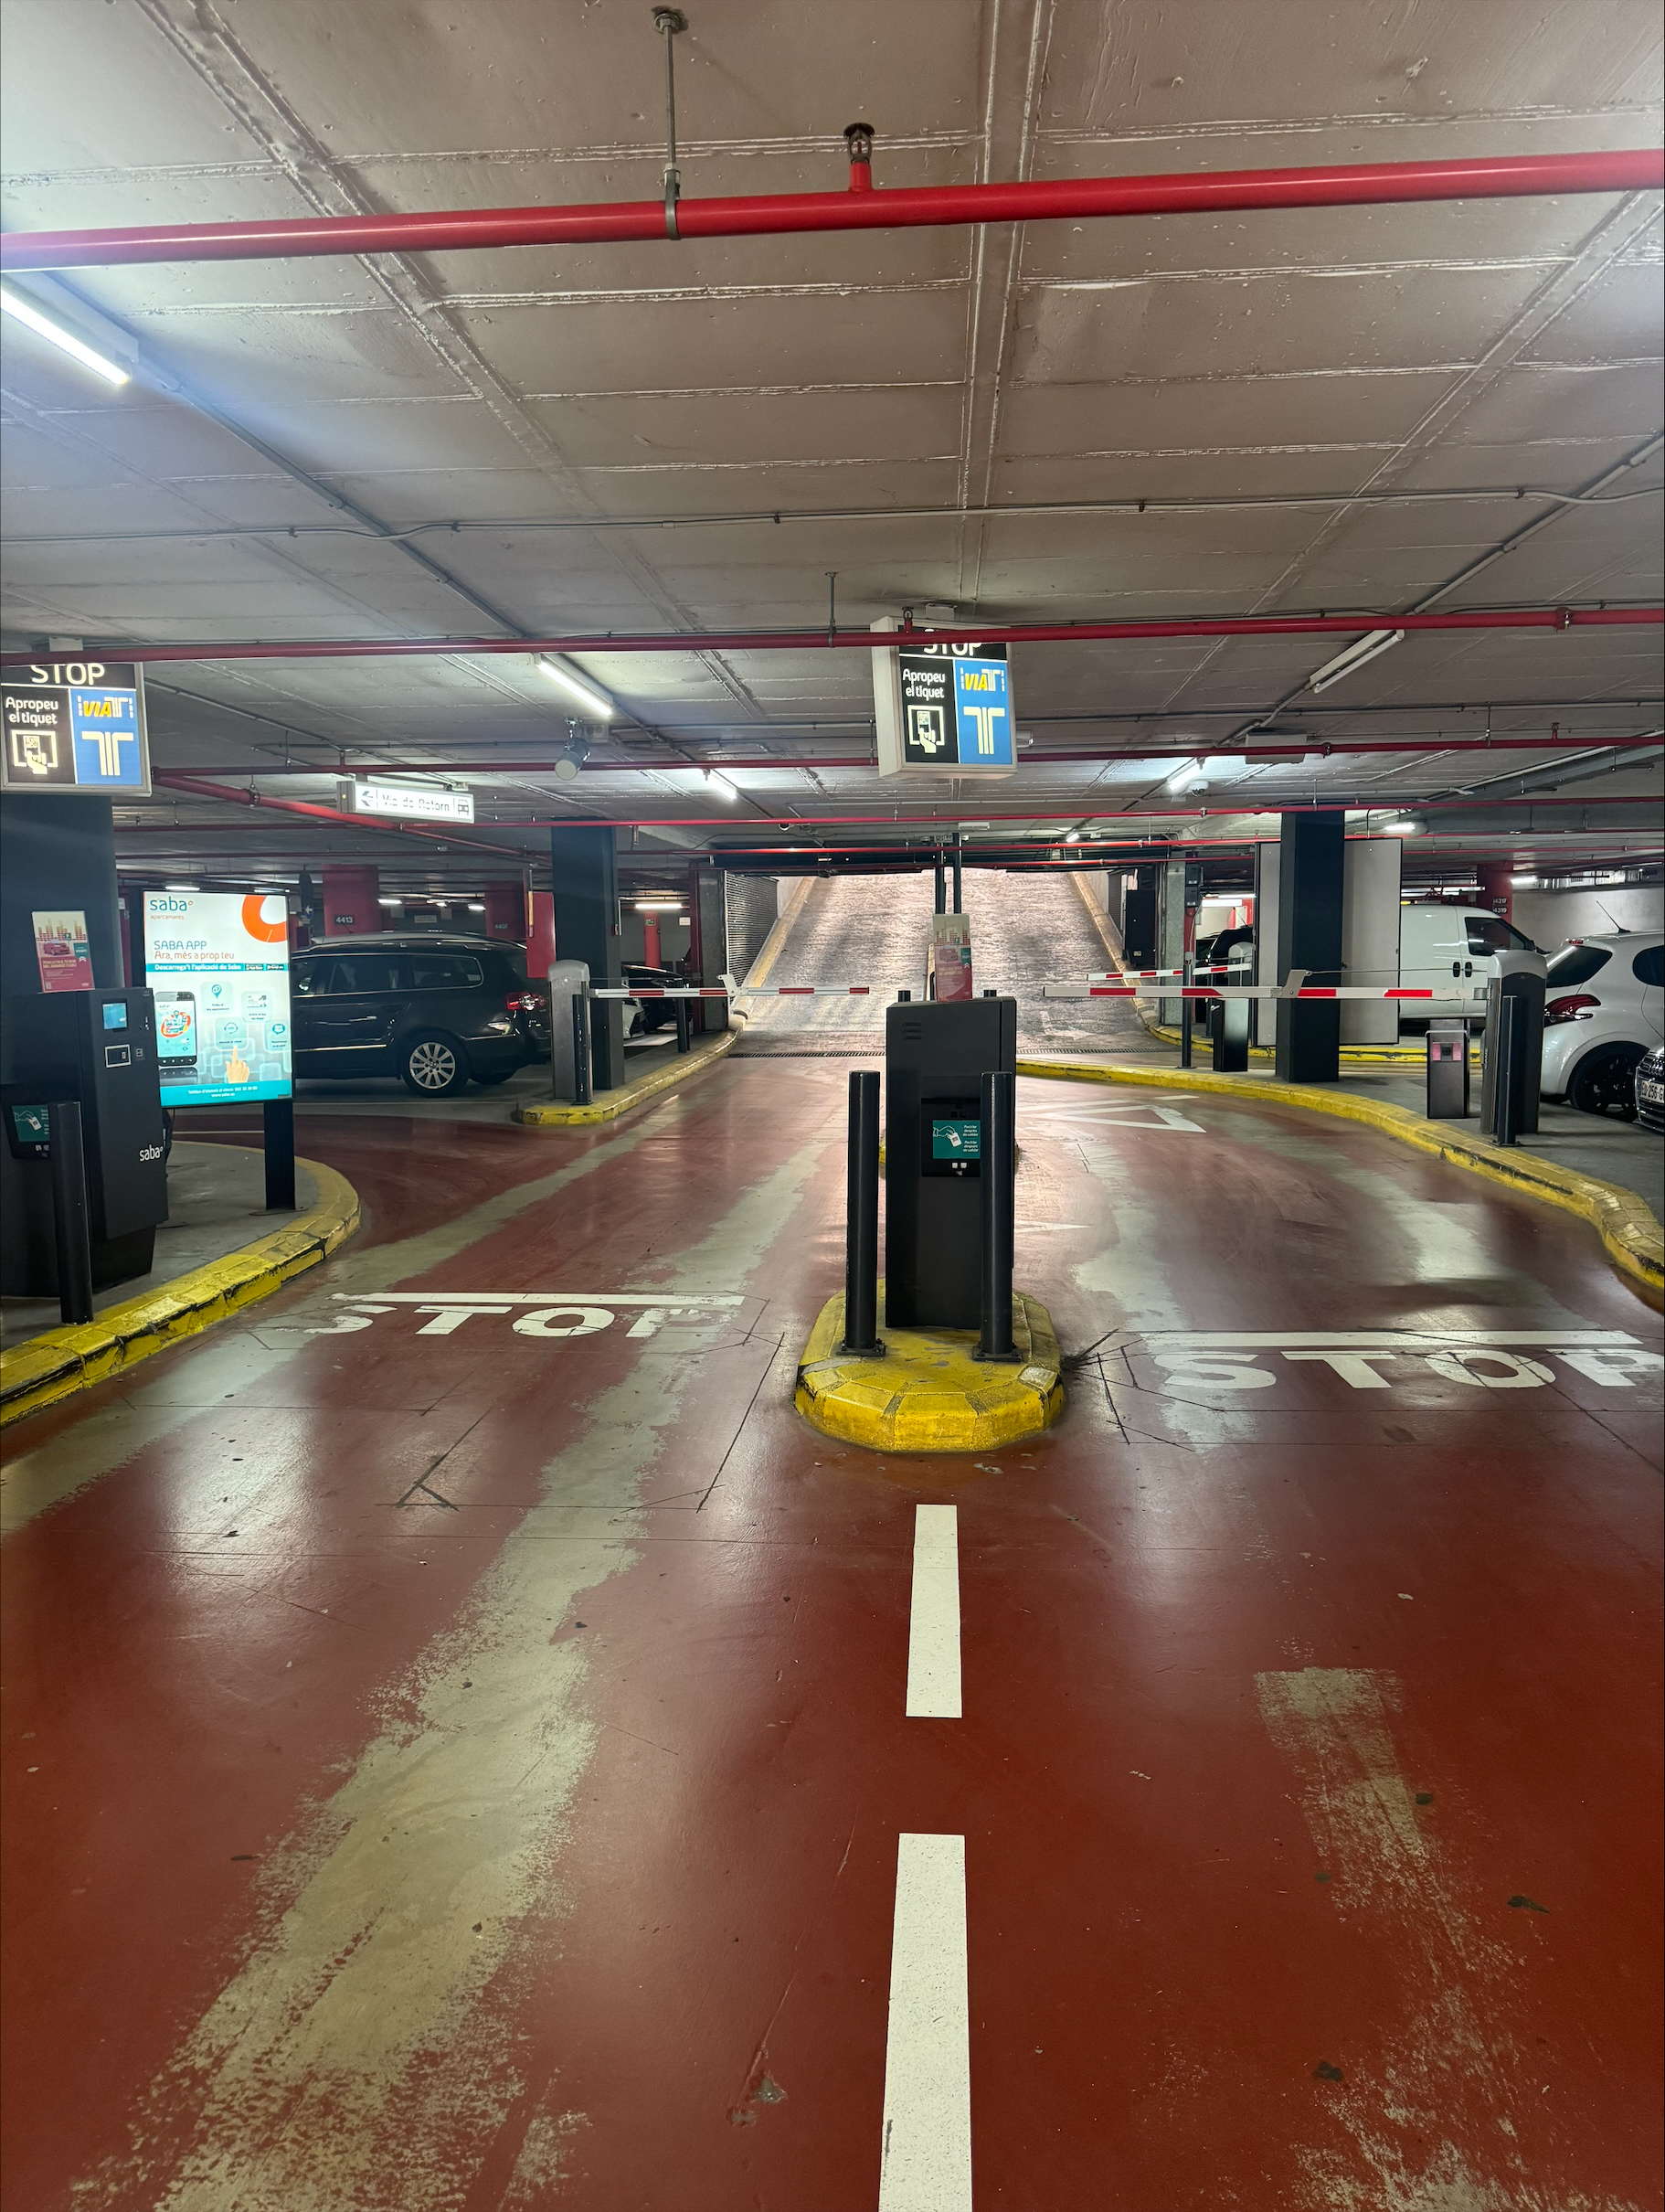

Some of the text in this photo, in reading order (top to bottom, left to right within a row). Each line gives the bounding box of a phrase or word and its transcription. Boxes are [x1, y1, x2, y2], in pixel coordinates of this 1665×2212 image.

[29, 663, 105, 686] STOP
[902, 668, 946, 686] Apropeu
[905, 685, 945, 701] el tiquet
[5, 697, 58, 712] Apropeu
[9, 711, 58, 727] el tiquet
[149, 896, 188, 911] saba
[154, 940, 207, 951] SABA APP
[154, 951, 173, 961] Ara,
[174, 951, 192, 960] més
[200, 953, 219, 962] prop
[221, 952, 235, 960] teu
[139, 1144, 161, 1162] saba
[1153, 1348, 1665, 1389] STOP
